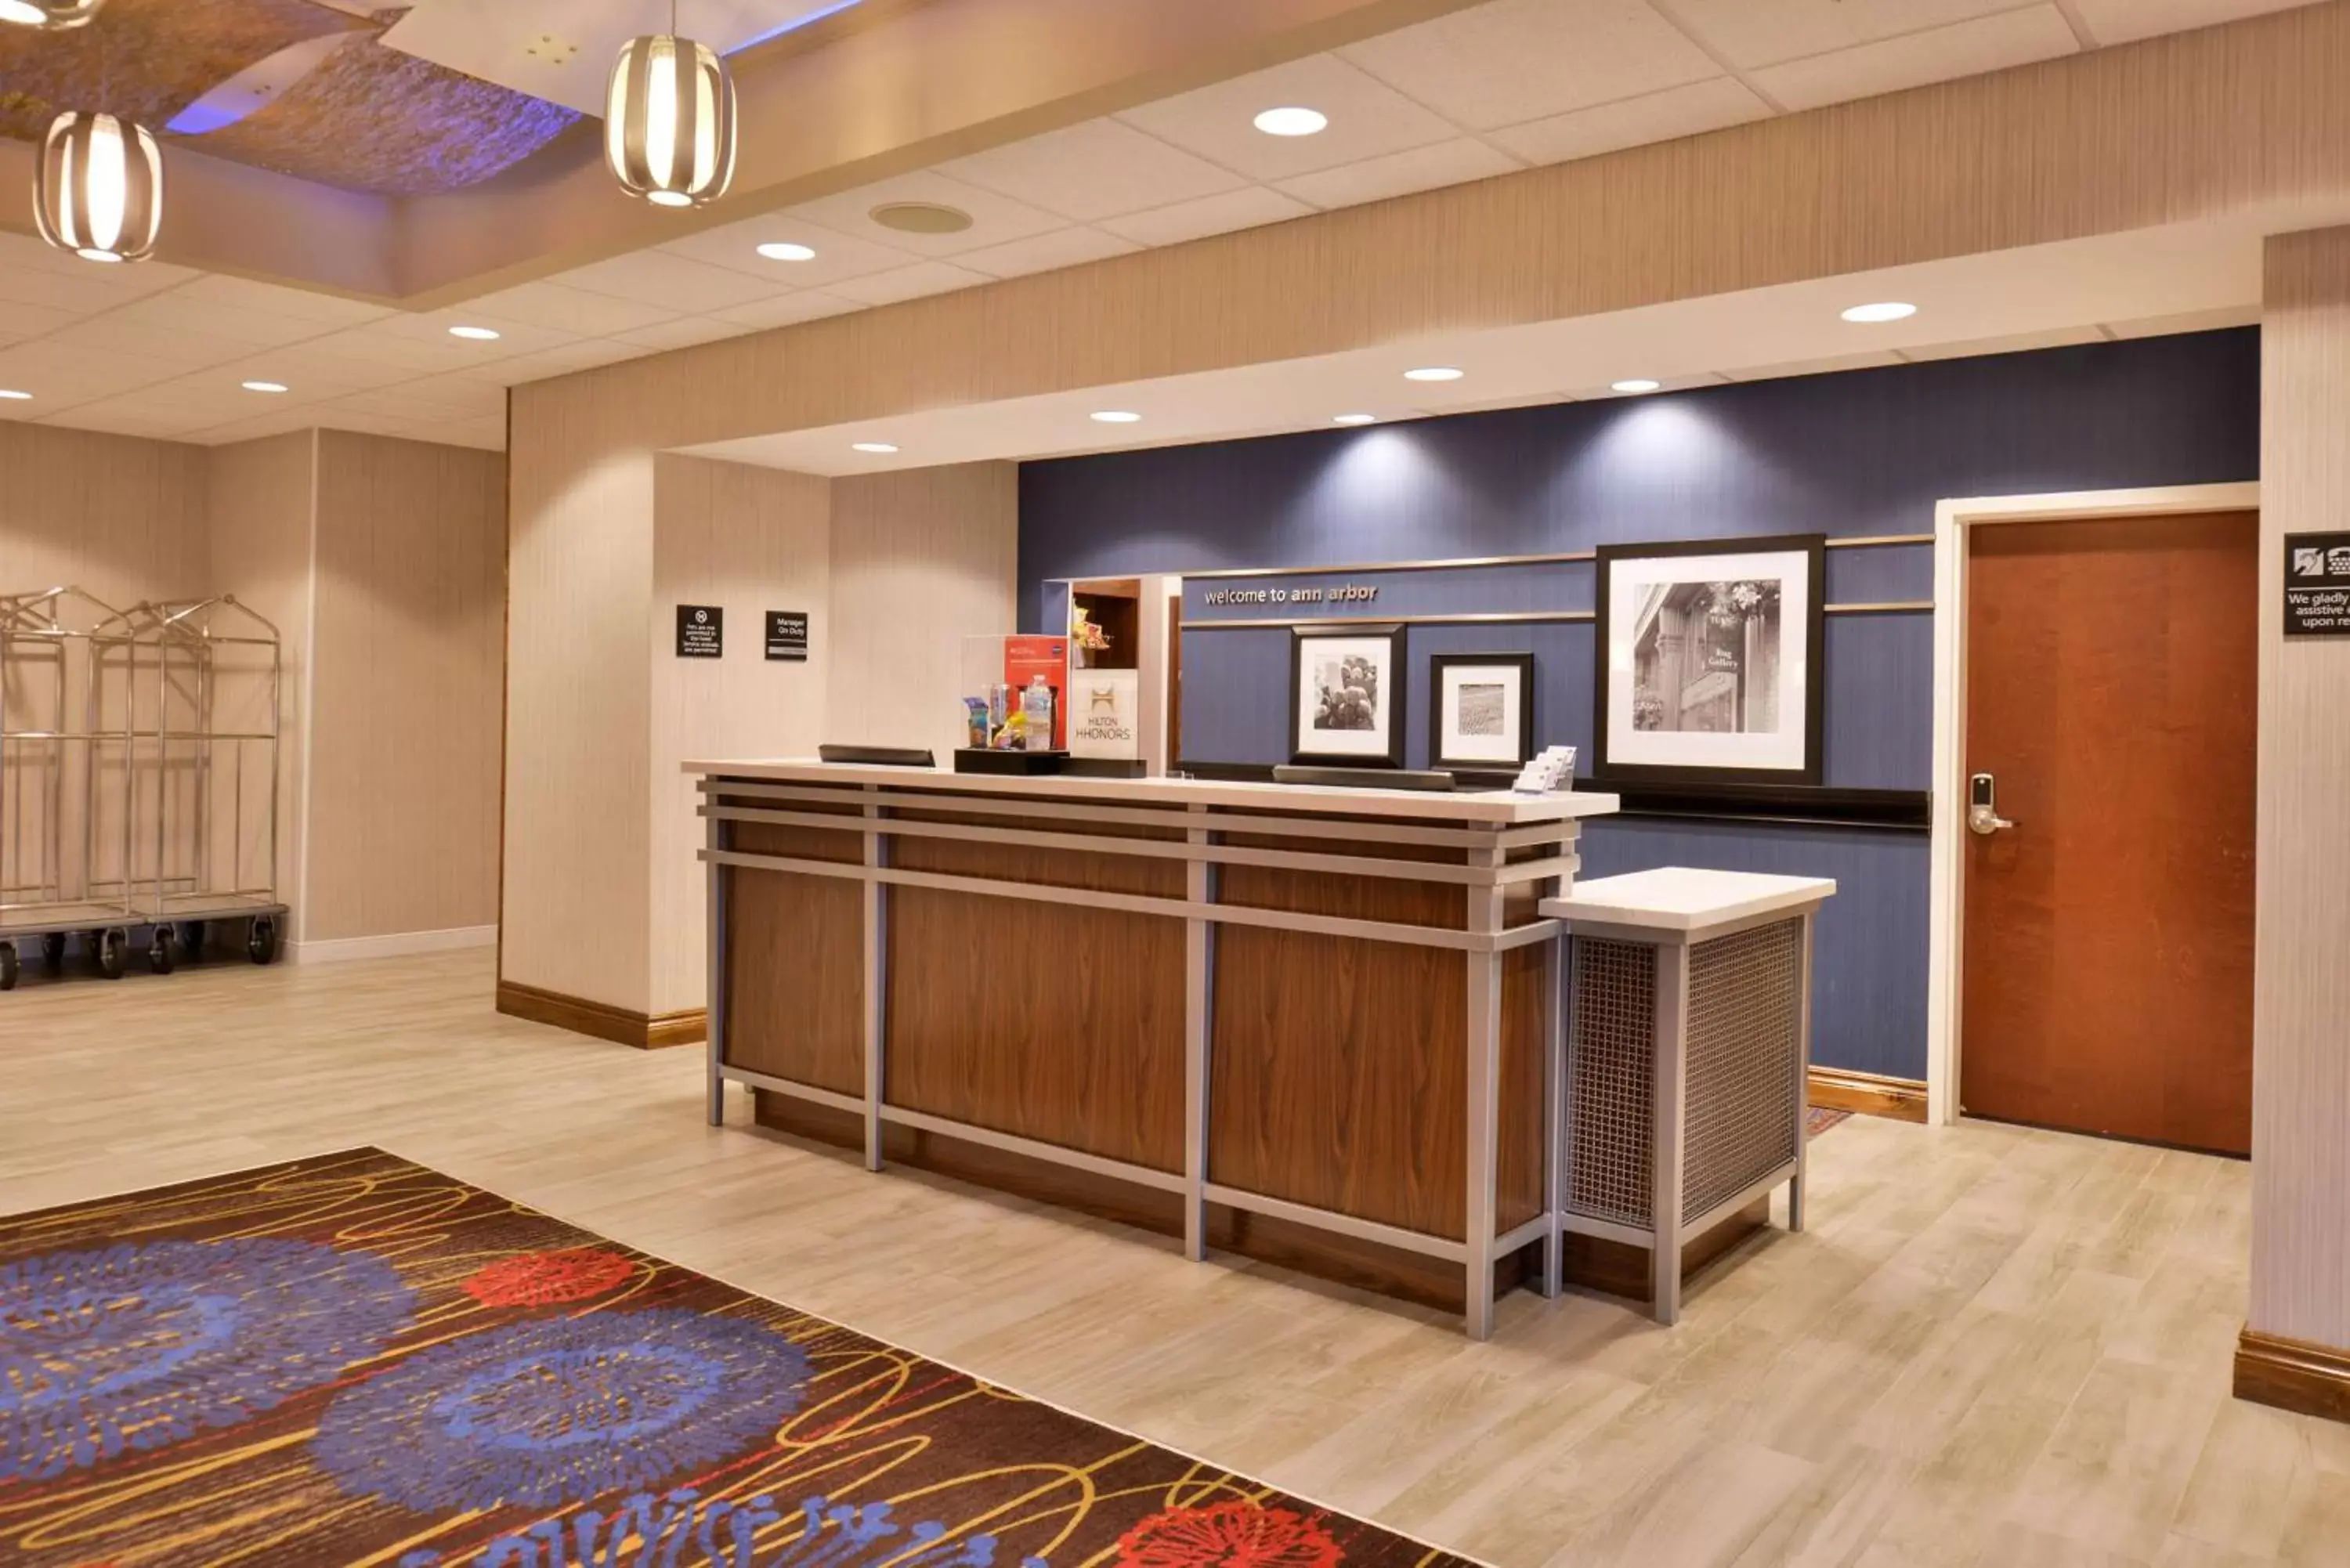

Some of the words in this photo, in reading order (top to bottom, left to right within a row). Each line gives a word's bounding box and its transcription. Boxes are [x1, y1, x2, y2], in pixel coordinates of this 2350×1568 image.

[1205, 589, 1267, 604] welcome
[1271, 589, 1286, 602] to
[1291, 589, 1322, 602] ann
[1329, 583, 1379, 602] arbor
[2288, 594, 2309, 604] We
[2312, 592, 2349, 607] gladly
[2296, 605, 2345, 616] assistive
[2302, 618, 2334, 628] upon
[1087, 717, 1119, 726] HILTON
